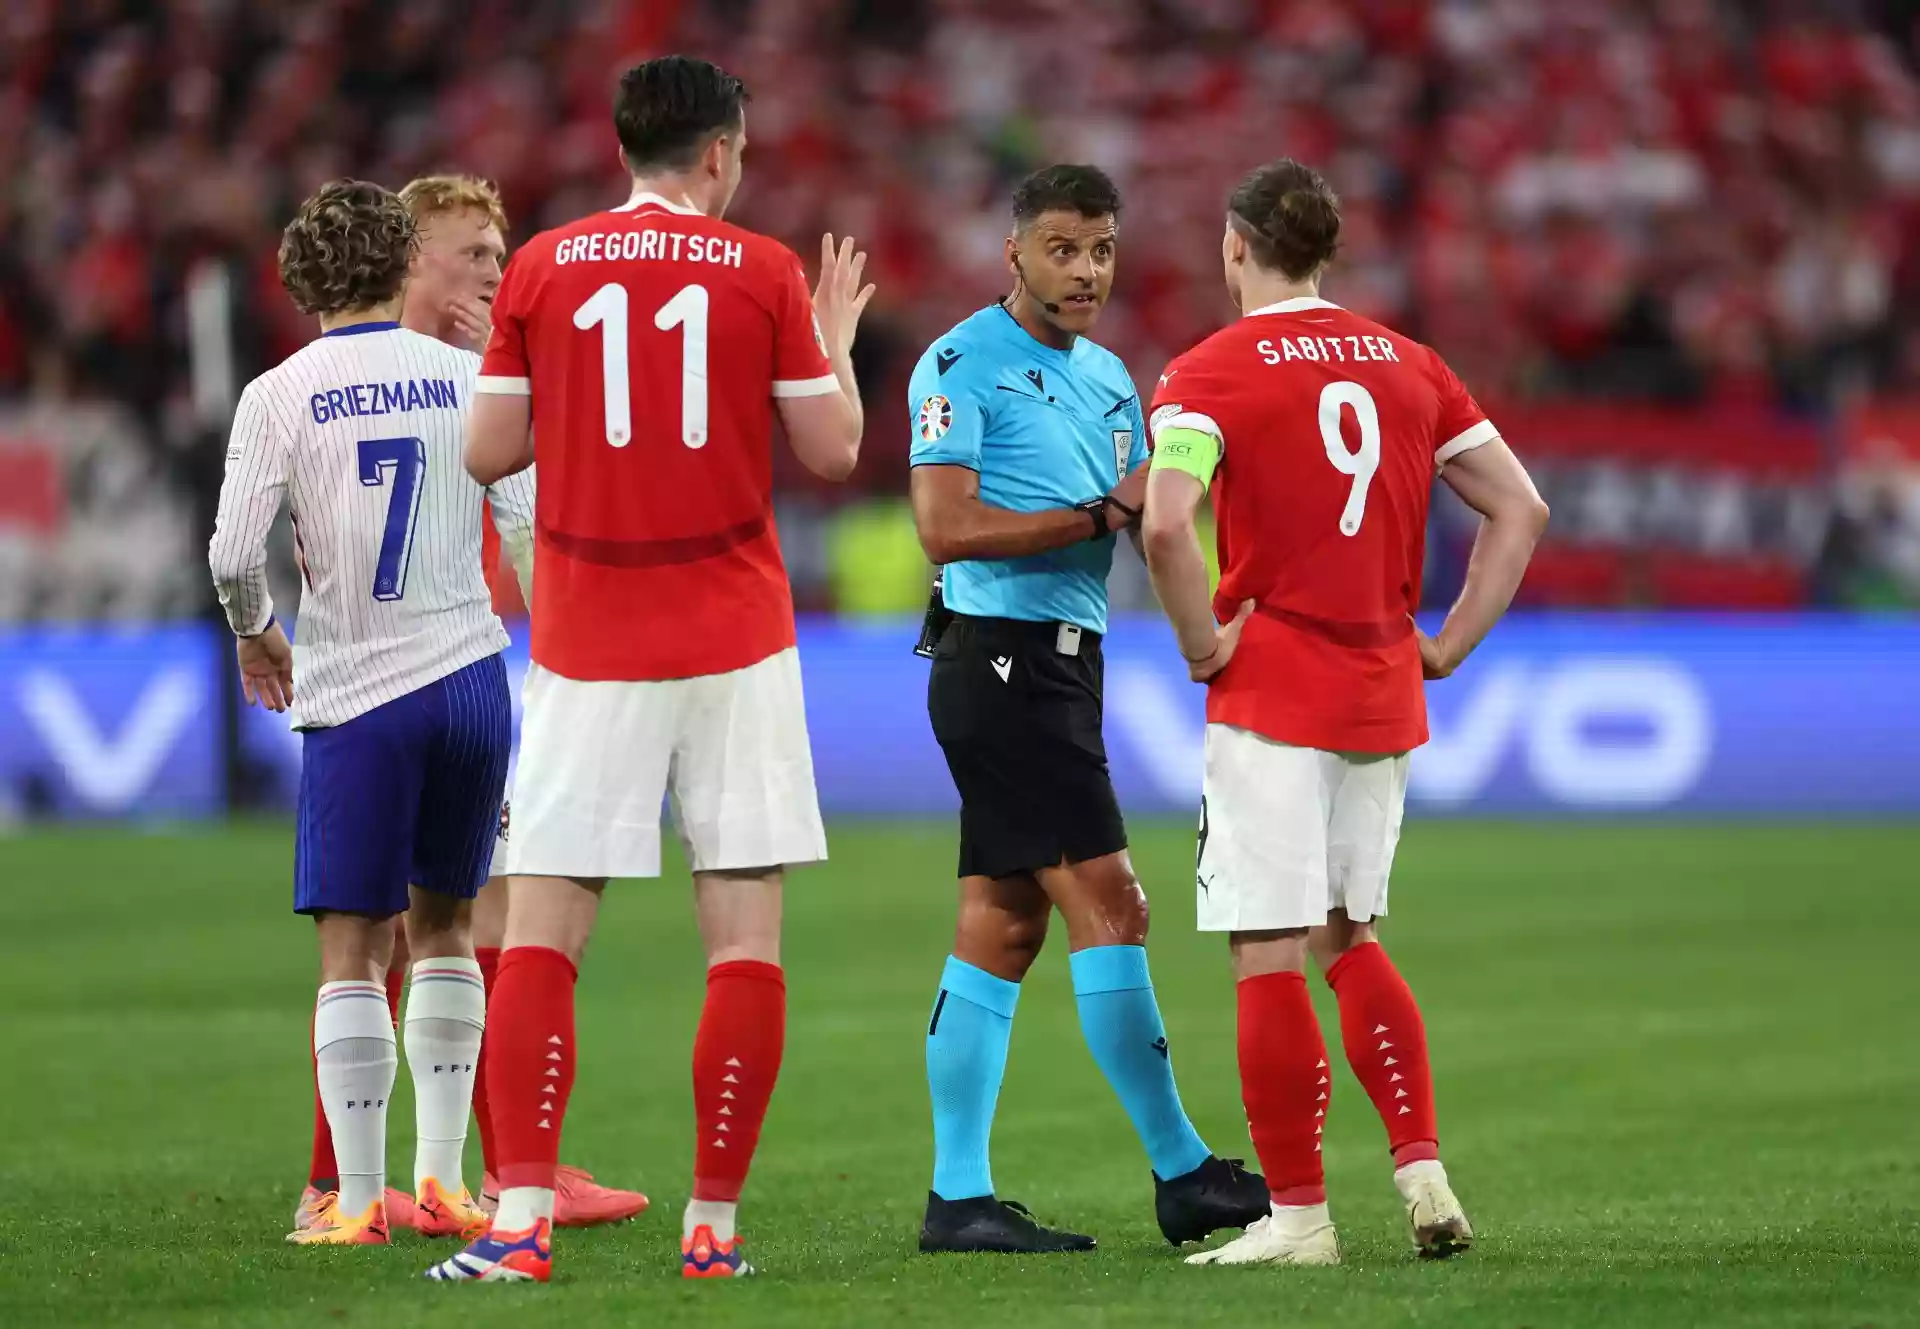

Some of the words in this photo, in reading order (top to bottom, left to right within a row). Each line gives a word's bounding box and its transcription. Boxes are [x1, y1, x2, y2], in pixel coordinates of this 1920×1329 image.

[555, 229, 742, 268] GREGORITSCH
[573, 282, 709, 449] 11
[1256, 336, 1400, 365] SABITZER
[310, 379, 459, 425] GRIEZMANN
[1318, 381, 1381, 537] 9
[357, 437, 426, 601] 7
